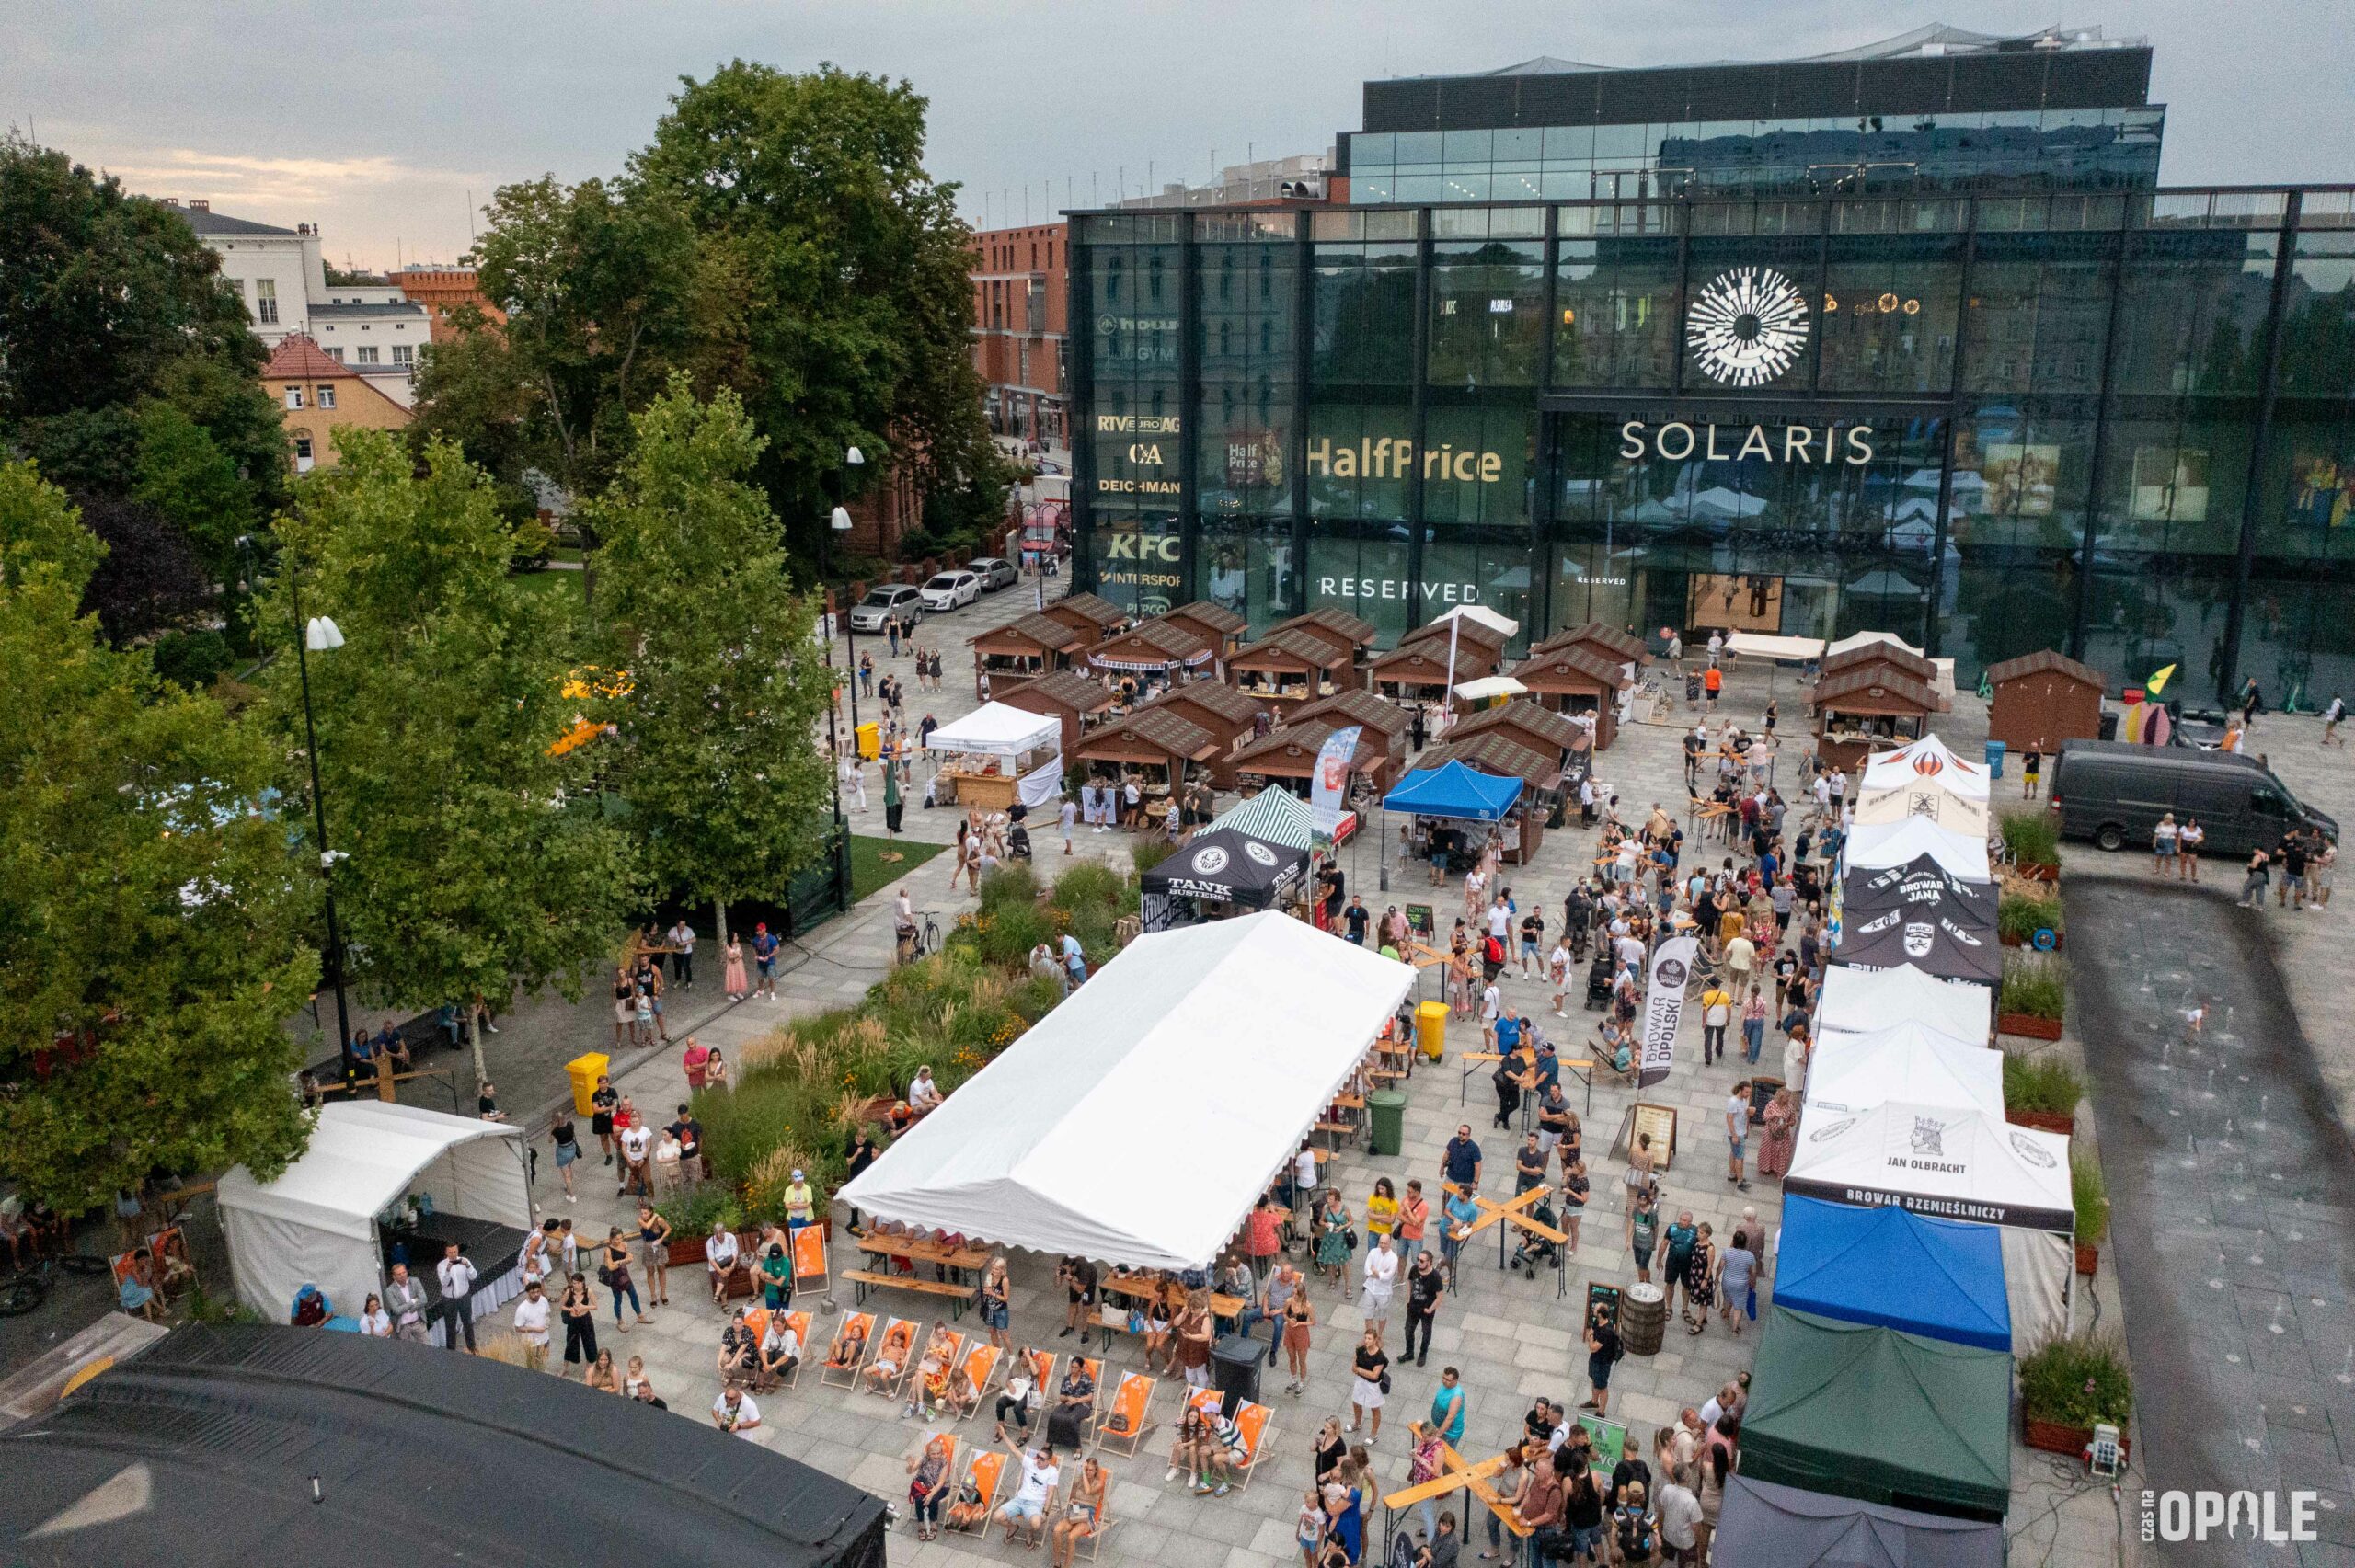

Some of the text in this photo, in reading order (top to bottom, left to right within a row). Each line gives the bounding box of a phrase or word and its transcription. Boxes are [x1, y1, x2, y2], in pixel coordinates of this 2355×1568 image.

[1137, 347, 1174, 361] GYM
[1229, 443, 1258, 457] Half
[1620, 420, 1873, 465] SOLARIS
[1129, 443, 1164, 464] C&A
[1229, 456, 1258, 468] Prie
[1307, 437, 1502, 482] HalfPrice
[1106, 533, 1181, 562] KFC
[1578, 577, 1626, 586] RESERVED
[1271, 861, 1300, 888] TANK
[1167, 877, 1233, 897] TANK
[1168, 888, 1226, 901] BUSTERS
[1899, 879, 1945, 894] BROWAR
[1907, 889, 1942, 902] JANA
[1646, 996, 1667, 1063] BROWAR
[1658, 998, 1682, 1061] OPOLSKI
[1887, 1156, 1967, 1173] JAN OLBRACHT
[1846, 1188, 2005, 1220] BROWAR RZEMIEŚLNICZY
